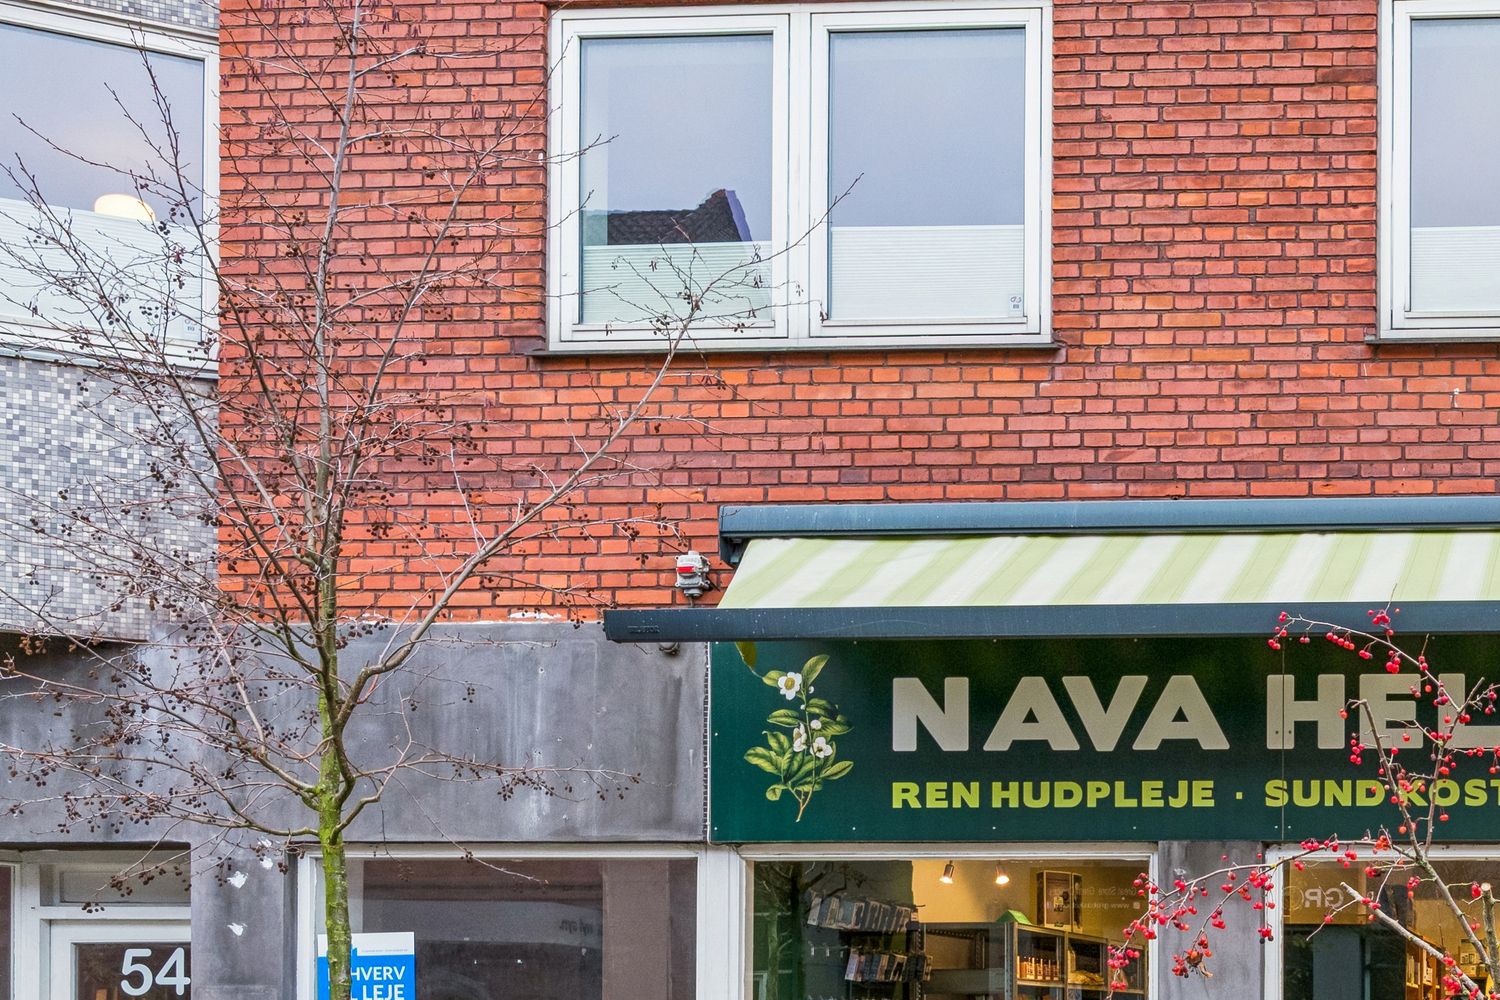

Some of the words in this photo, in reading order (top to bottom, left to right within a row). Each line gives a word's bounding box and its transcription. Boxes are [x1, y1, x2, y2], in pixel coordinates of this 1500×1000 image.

[892, 674, 1231, 752] NAVA
[892, 781, 980, 809] REN
[991, 780, 1215, 808] HUDPLEJE
[1264, 779, 1386, 807] SUND
[121, 947, 191, 996] 54
